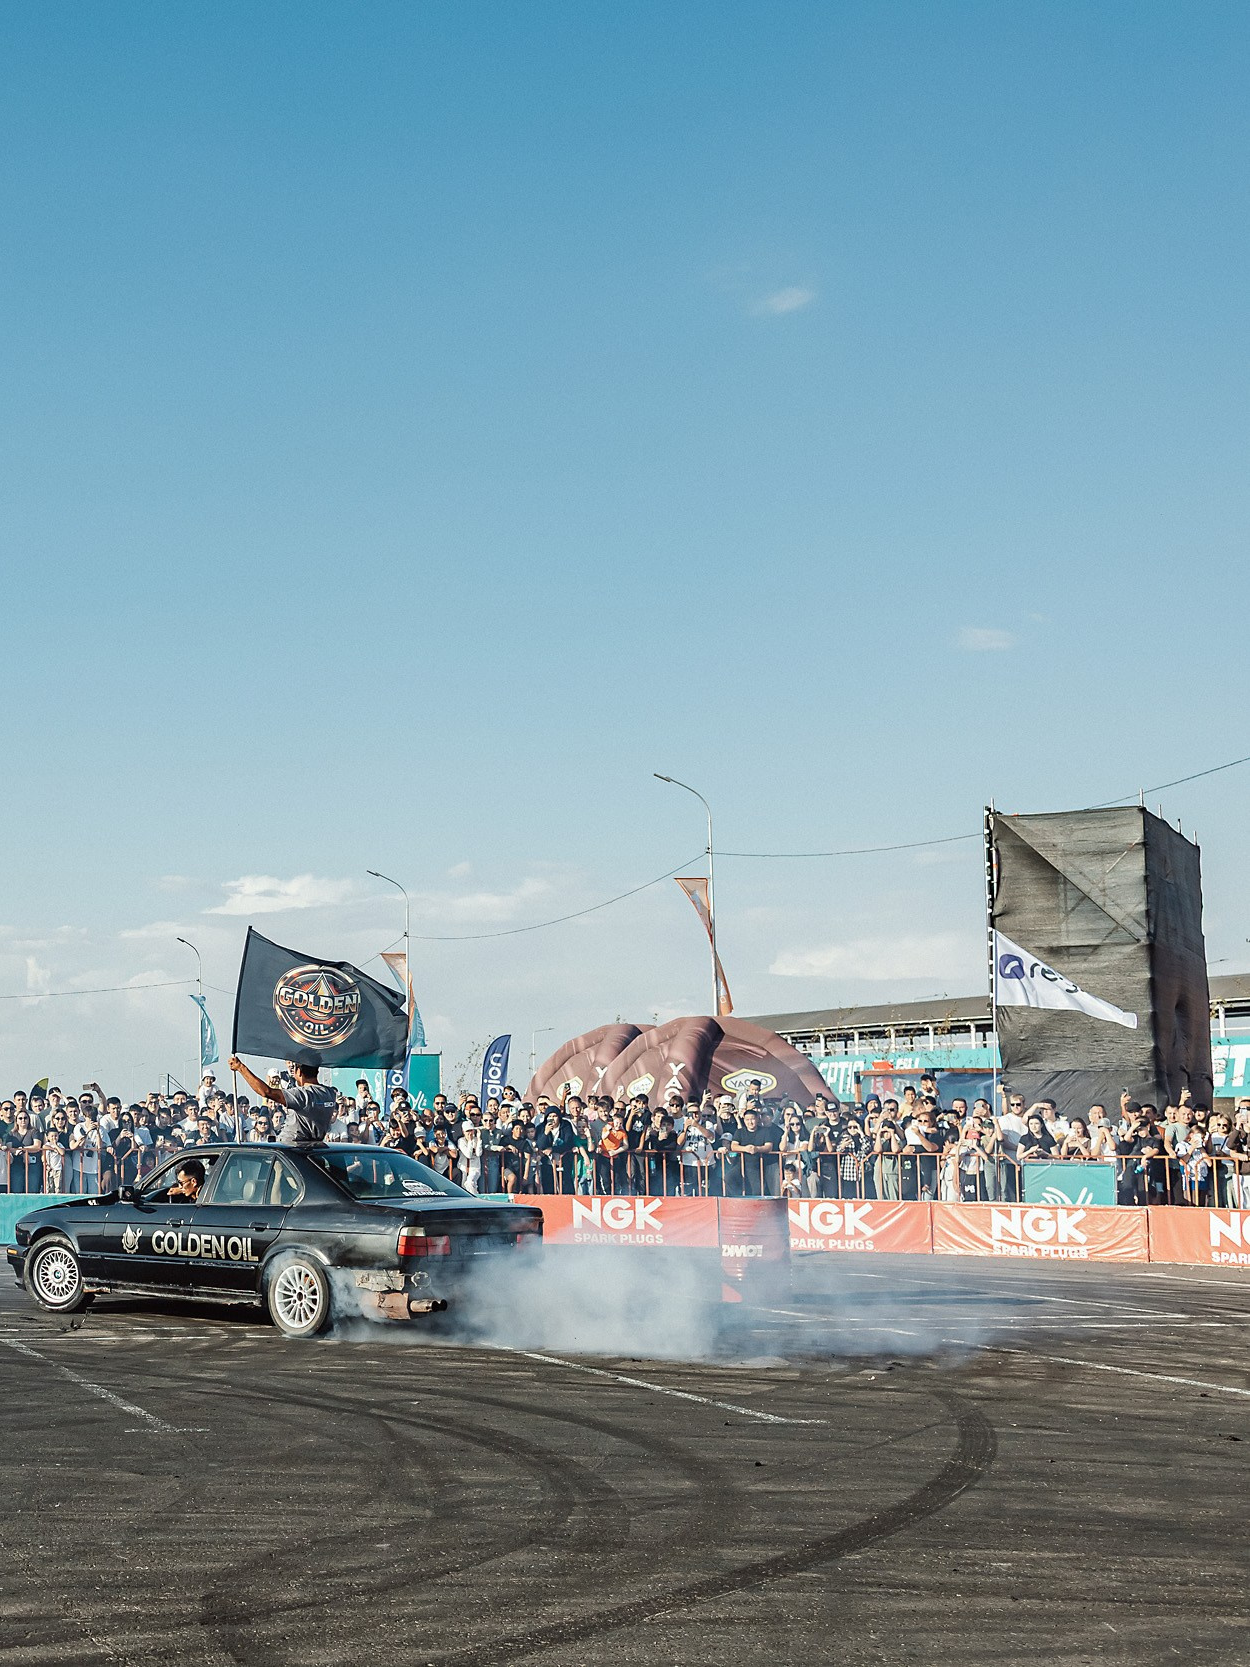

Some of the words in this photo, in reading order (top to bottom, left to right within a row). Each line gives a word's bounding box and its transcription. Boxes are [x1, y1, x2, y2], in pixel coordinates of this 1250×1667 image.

[278, 987, 358, 1015] GOLDEN
[303, 1022, 329, 1035] OIL
[731, 1078, 768, 1088] YACO
[572, 1197, 663, 1231] NGK
[991, 1207, 1088, 1245] NGK
[574, 1232, 616, 1243] SPARK
[620, 1234, 664, 1244] PLUGS
[791, 1238, 824, 1249] PARK
[829, 1238, 874, 1251] PLUGS
[152, 1230, 225, 1259] GOLDEN
[227, 1236, 258, 1261] OIL
[993, 1244, 1038, 1257] SPARK
[1041, 1246, 1088, 1259] PLUGS
[1211, 1251, 1250, 1264] SPAR
